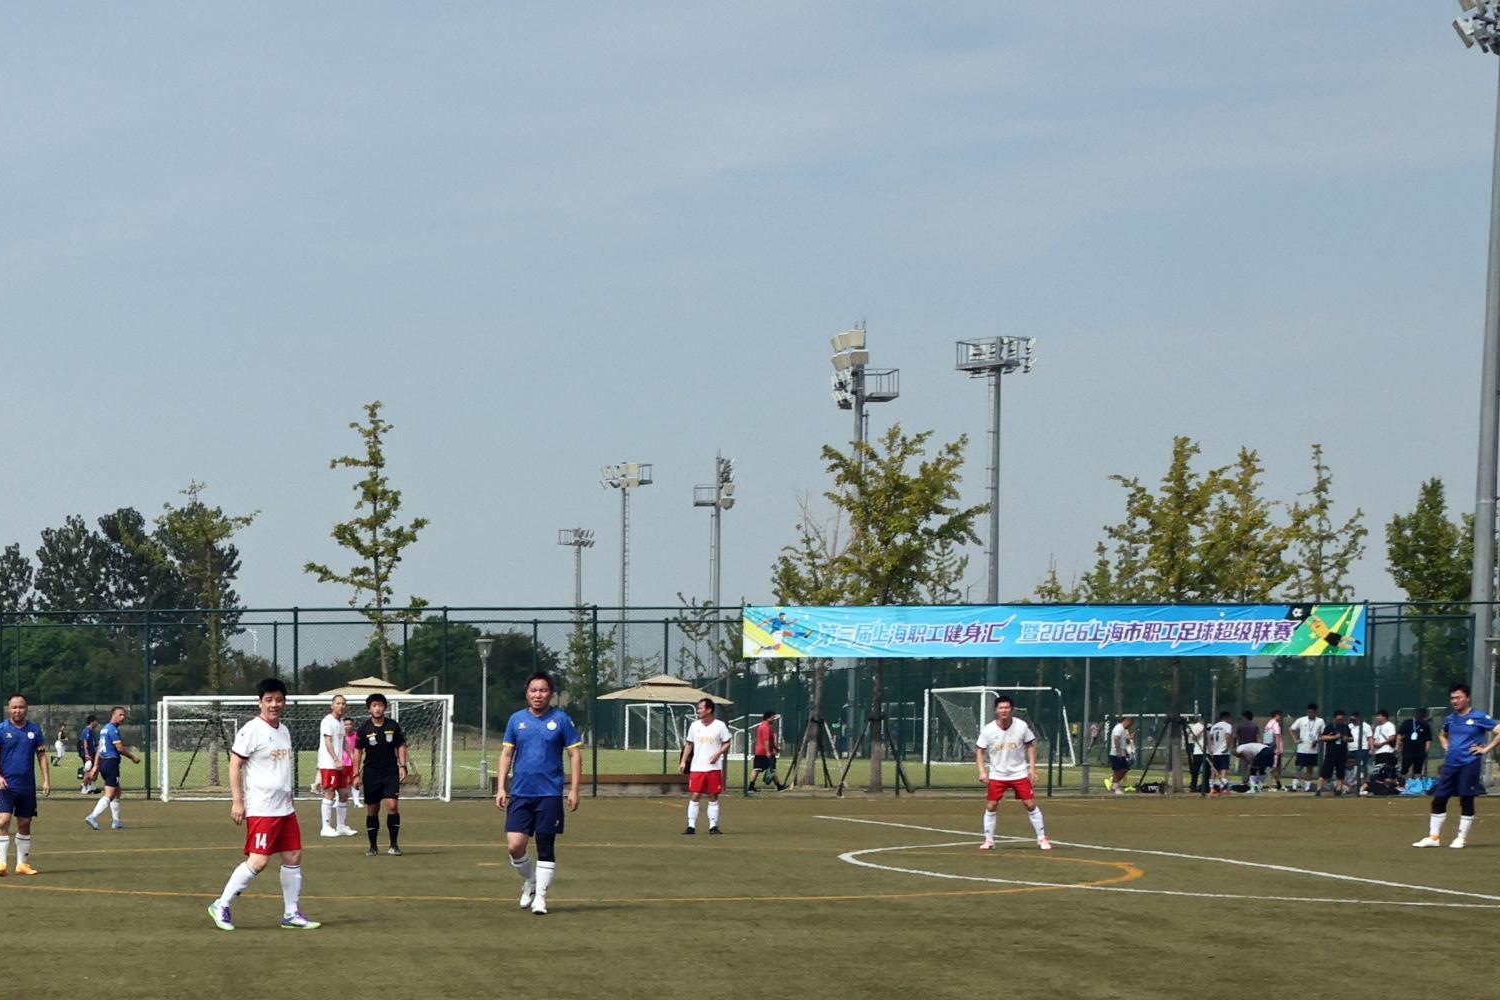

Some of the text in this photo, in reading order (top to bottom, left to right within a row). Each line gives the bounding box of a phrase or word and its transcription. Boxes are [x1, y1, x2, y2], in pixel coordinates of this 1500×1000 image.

[1016, 619, 1300, 649] 暨2026上海市职工足球超级联赛
[255, 833, 267, 849] 14
